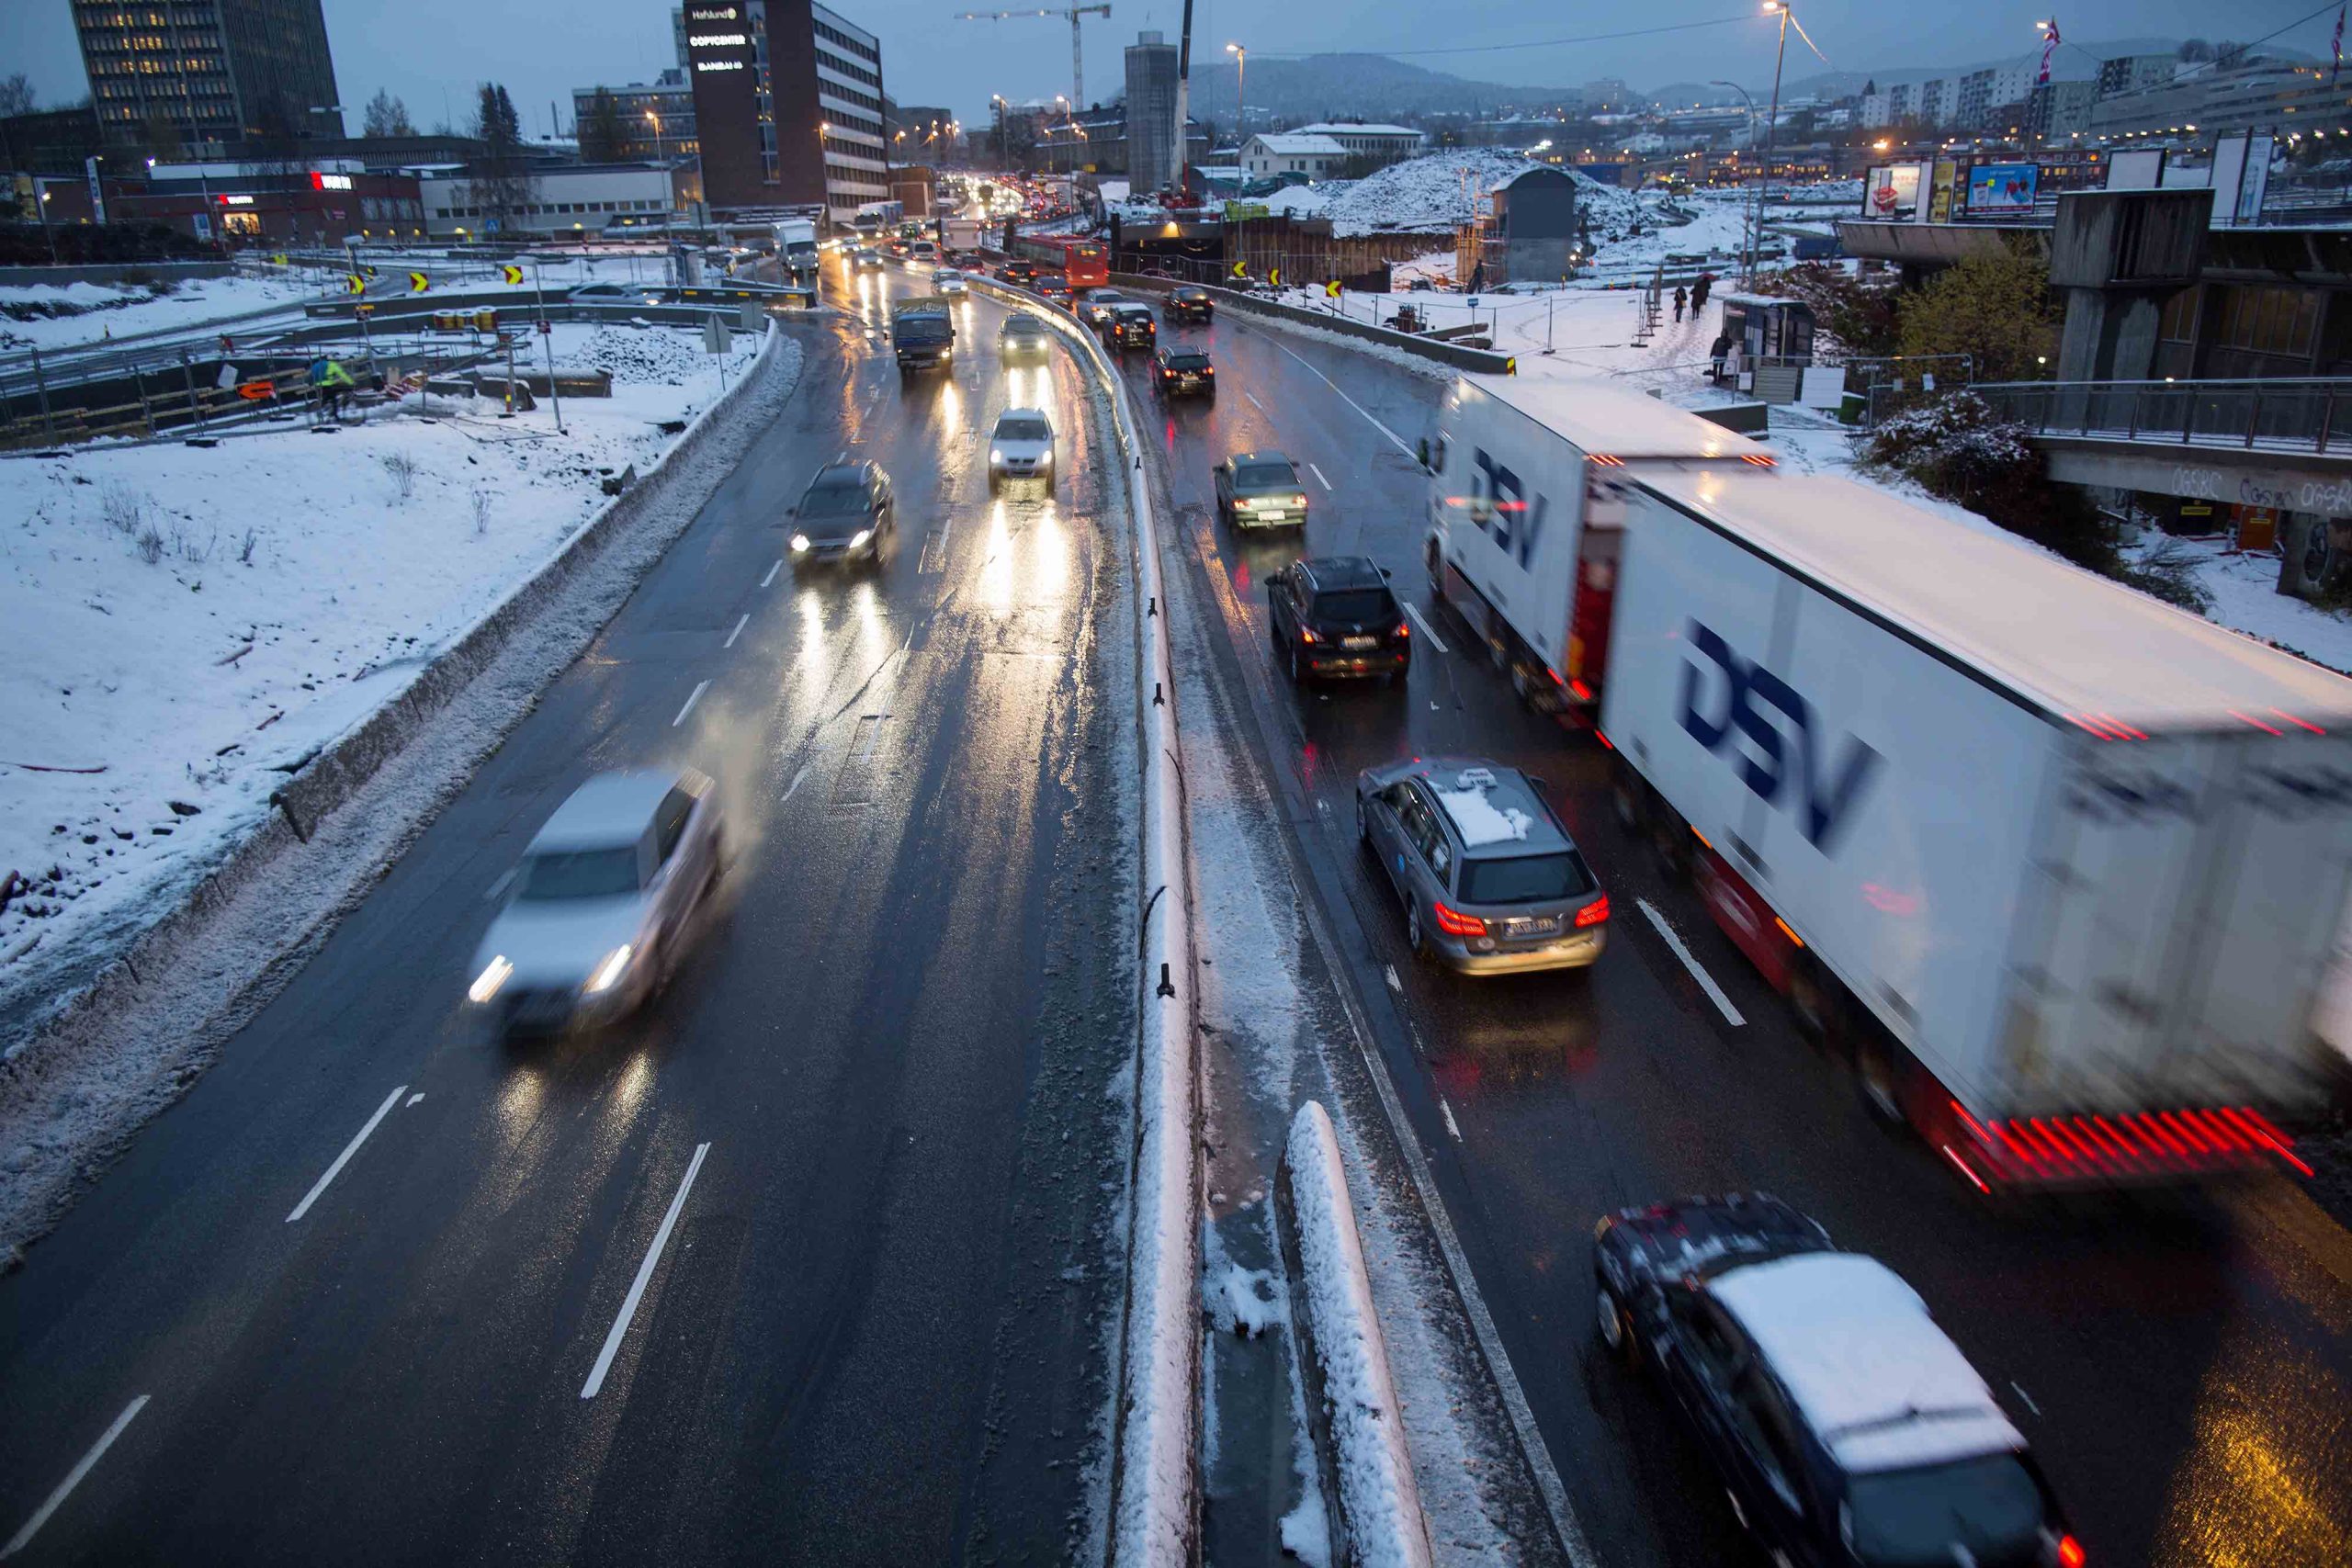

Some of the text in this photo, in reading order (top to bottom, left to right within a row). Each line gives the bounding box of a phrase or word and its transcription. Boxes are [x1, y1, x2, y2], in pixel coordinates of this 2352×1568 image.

[689, 34, 746, 47] COPYCENTER
[692, 9, 728, 20] Hafslund
[1470, 445, 1551, 574] DSV
[1673, 613, 1890, 861] DSV
